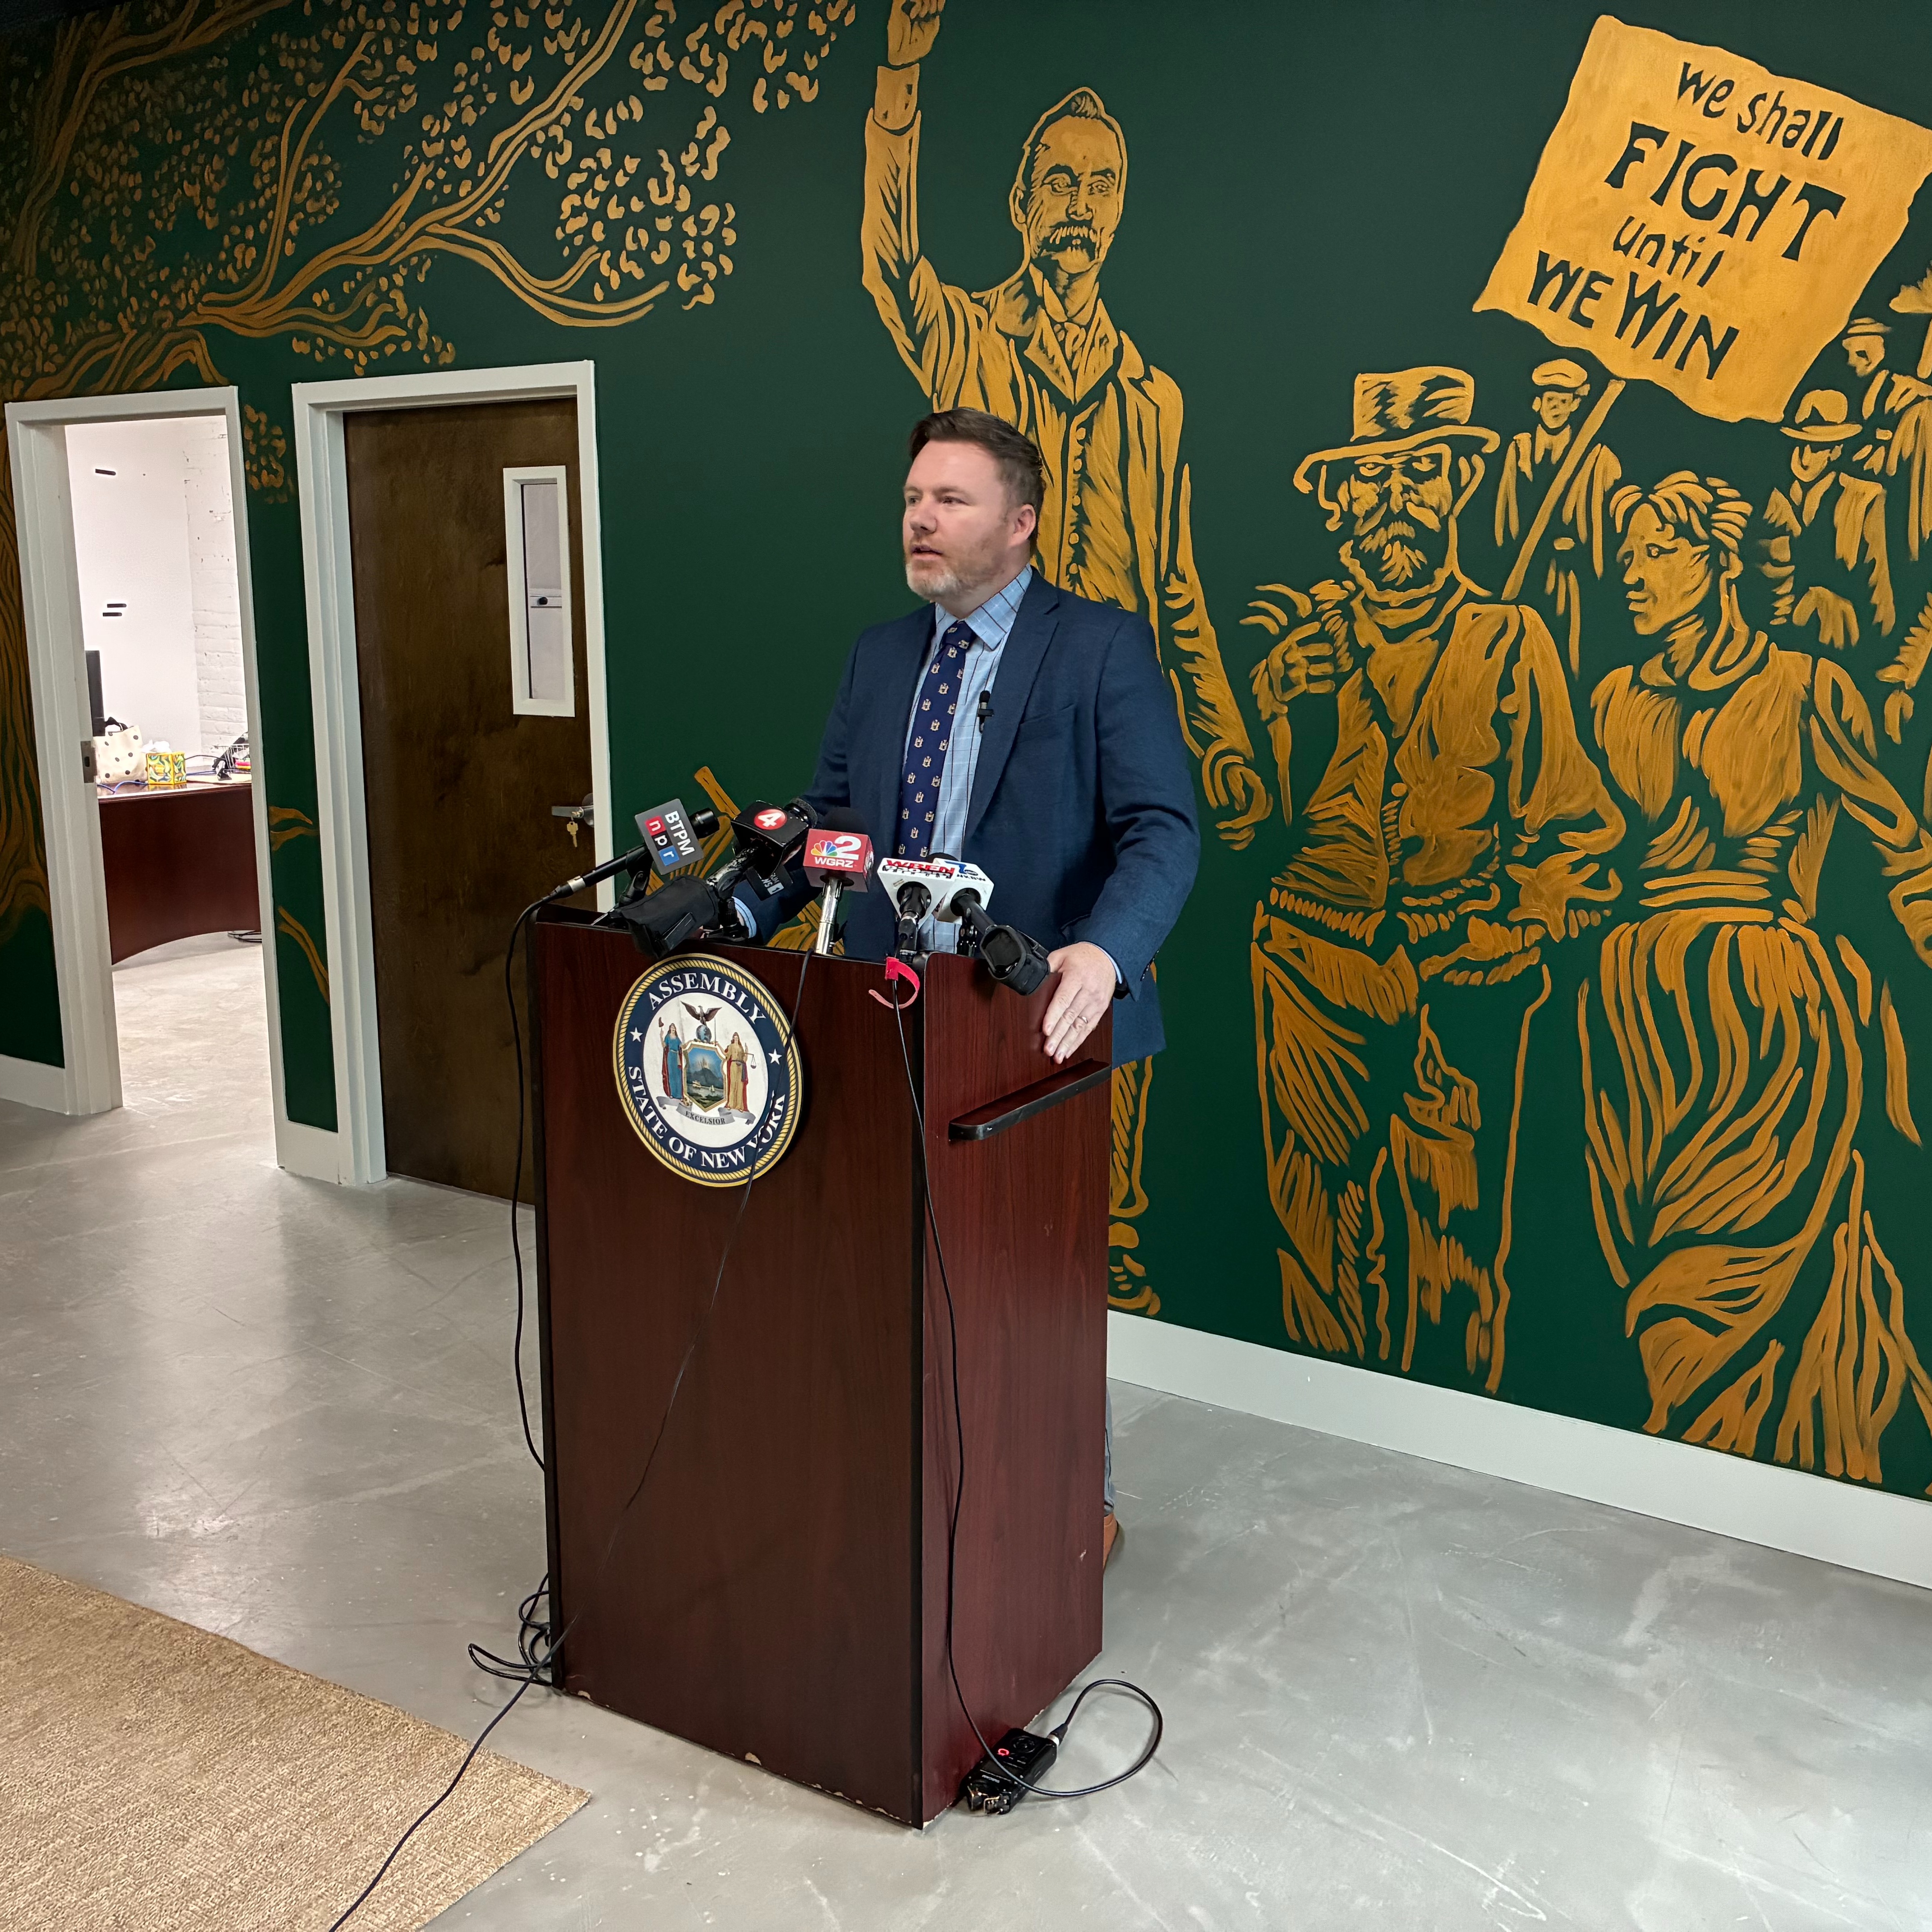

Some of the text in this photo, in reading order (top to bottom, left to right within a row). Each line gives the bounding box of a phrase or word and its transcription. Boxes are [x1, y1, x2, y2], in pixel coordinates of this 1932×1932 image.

[1737, 91, 1844, 160] shall
[1604, 121, 1846, 262] FIGHT
[1613, 216, 1725, 288] until
[1527, 250, 1739, 380] WE WIN
[649, 819, 675, 858] npr
[664, 810, 695, 856] BTPM
[758, 812, 782, 827] 4
[814, 856, 854, 868] WGRZ
[834, 835, 861, 860] 2
[886, 859, 955, 876] WBEN
[649, 972, 766, 1025] ASSEMBLY
[628, 1066, 668, 1140] STATE
[668, 1136, 697, 1161] OF
[701, 1146, 745, 1169] NEW
[685, 1110, 726, 1125] EXCELSIOR
